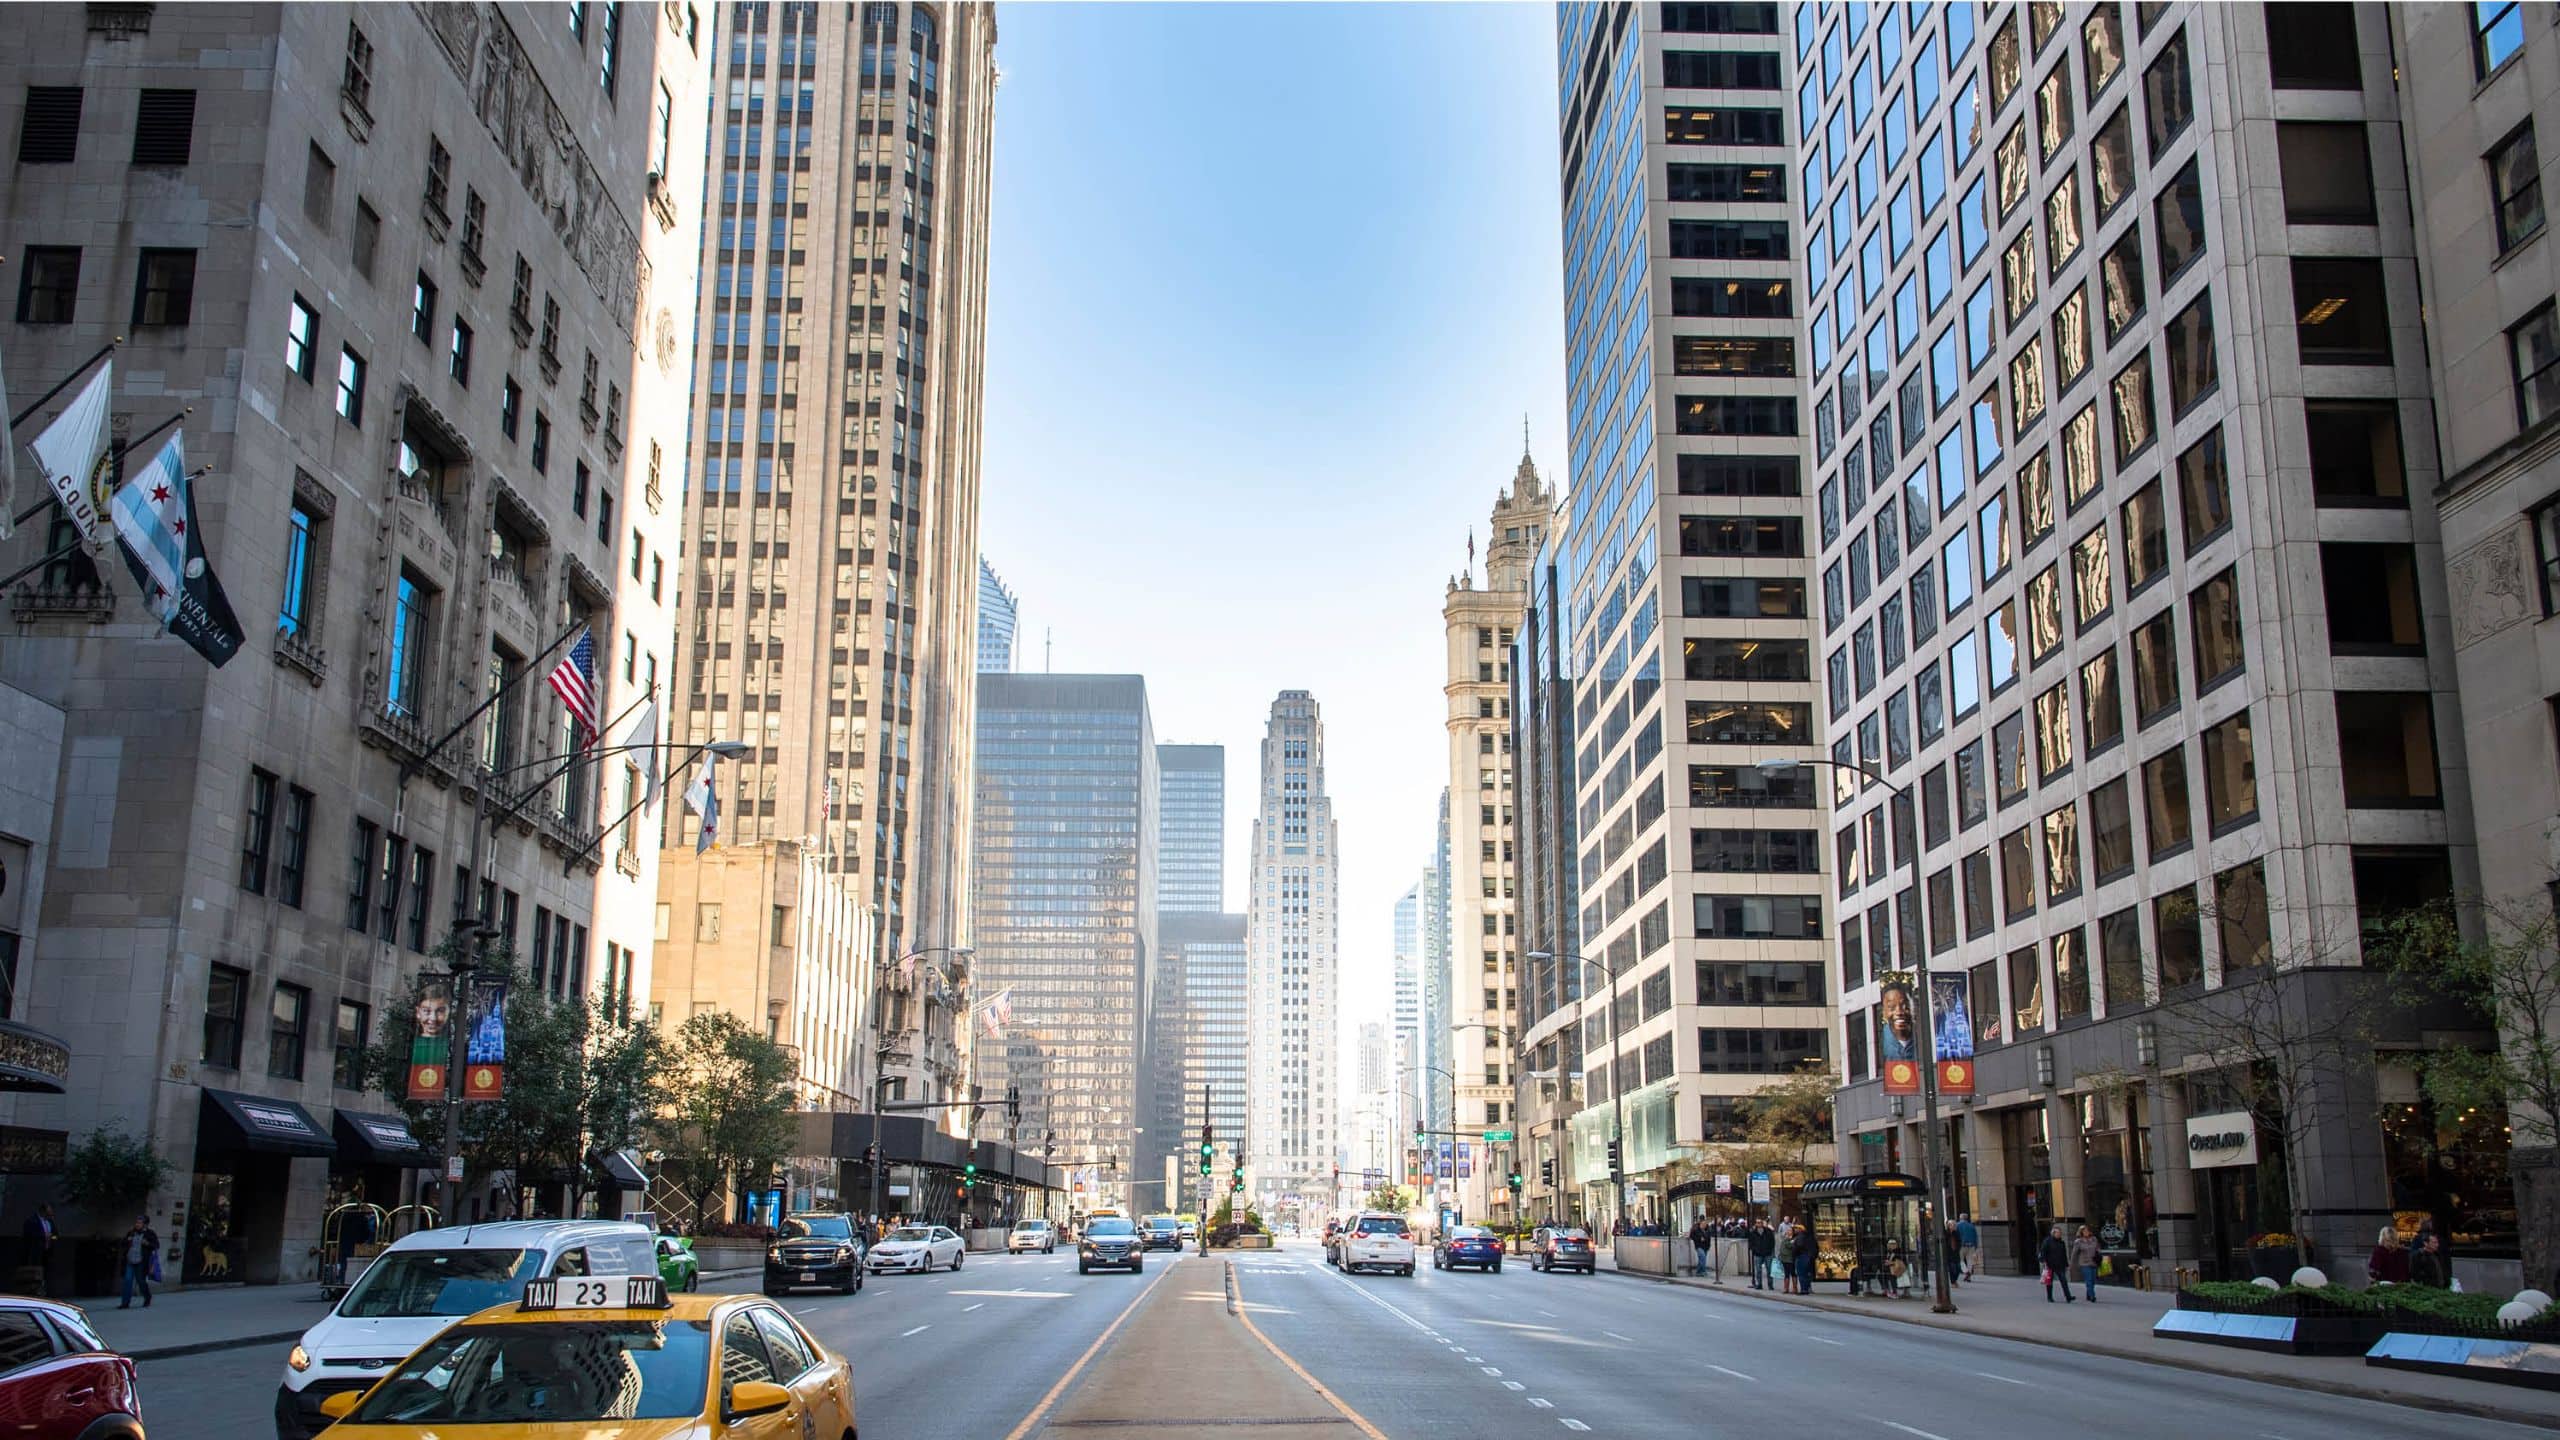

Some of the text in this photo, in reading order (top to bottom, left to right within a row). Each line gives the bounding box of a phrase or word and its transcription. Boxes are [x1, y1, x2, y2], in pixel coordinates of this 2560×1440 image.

[527, 1280, 656, 1307] TAXI 23 TAXI
